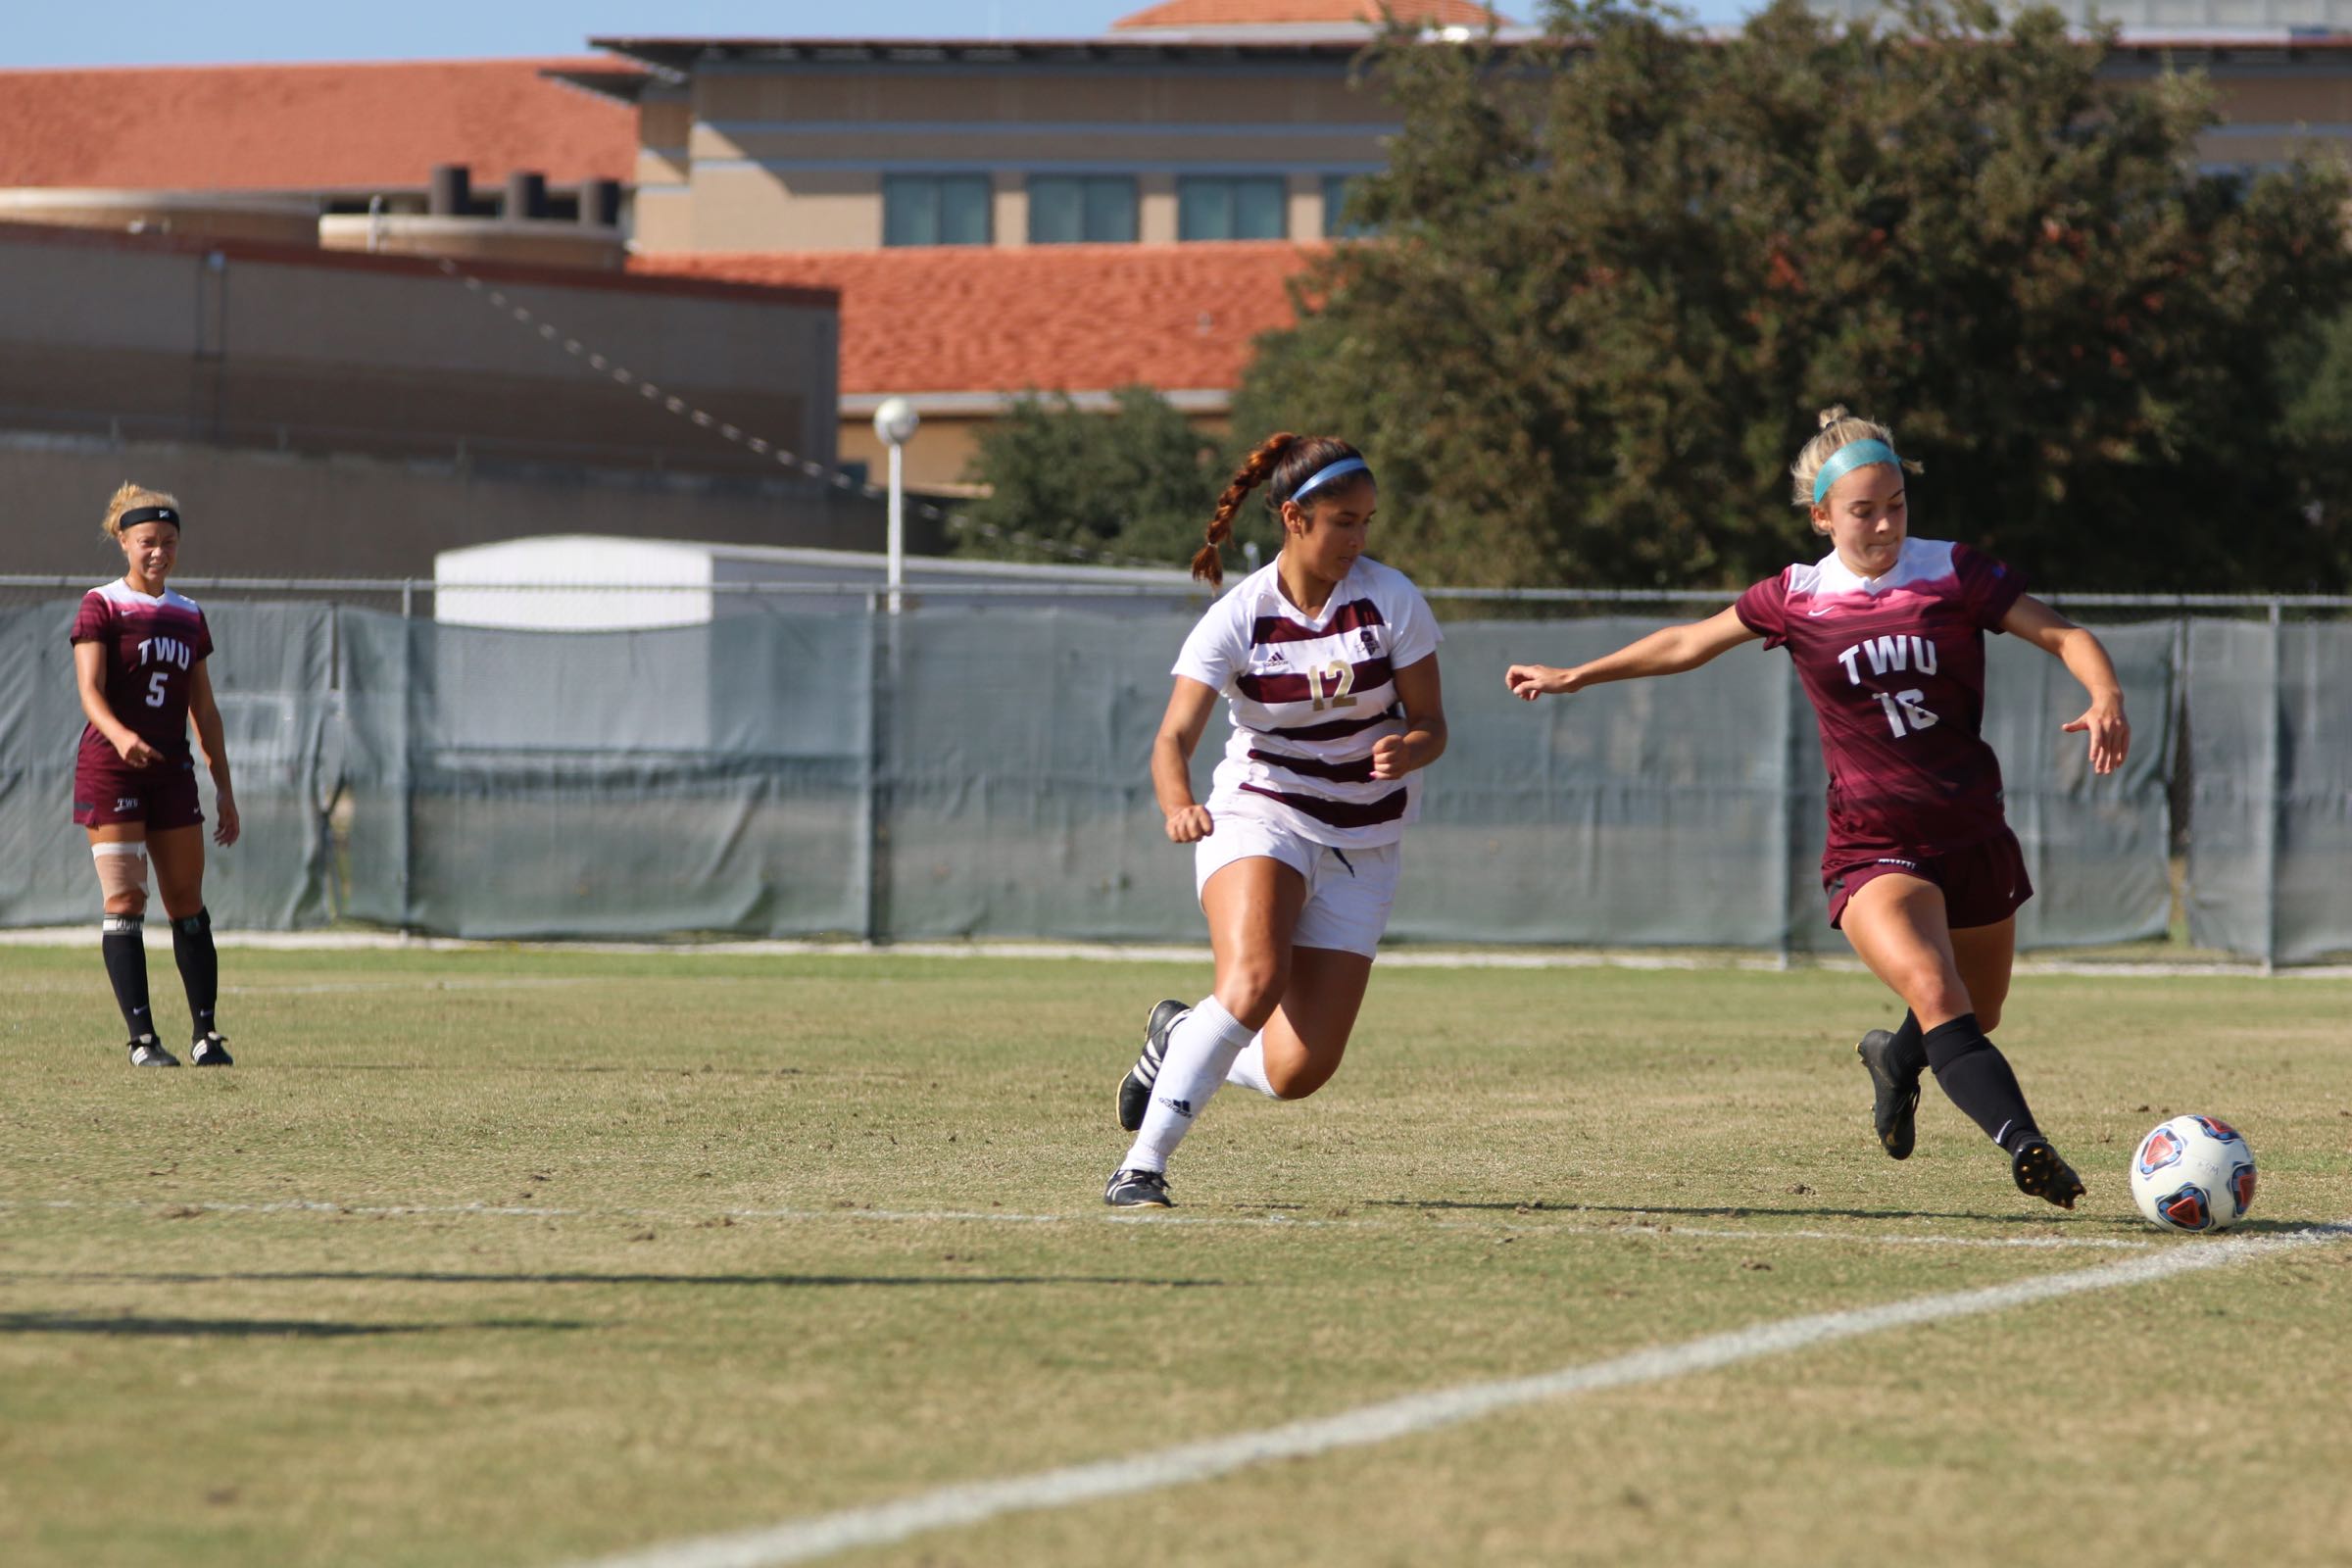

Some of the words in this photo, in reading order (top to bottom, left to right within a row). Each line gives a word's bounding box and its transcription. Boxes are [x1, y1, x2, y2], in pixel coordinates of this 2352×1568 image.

[138, 636, 190, 671] TWU
[1838, 634, 1937, 685] TWU
[145, 671, 169, 708] 5
[1306, 659, 1357, 711] 12
[1872, 688, 1939, 738] 16
[1158, 1097, 1193, 1118] adidas
